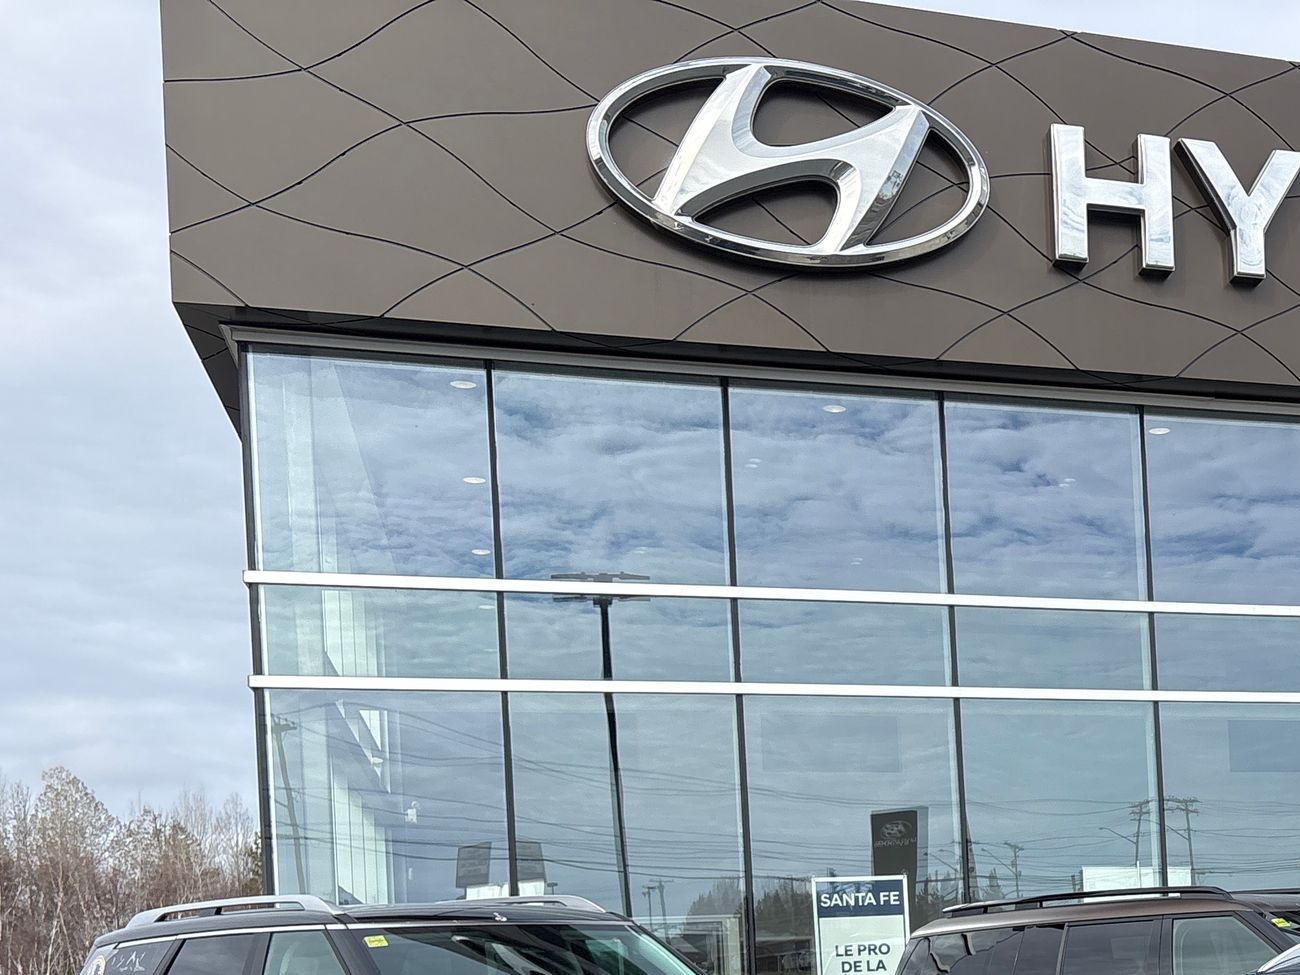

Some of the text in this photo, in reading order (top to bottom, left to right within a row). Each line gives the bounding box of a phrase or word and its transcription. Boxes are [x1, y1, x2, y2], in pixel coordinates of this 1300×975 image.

[820, 891, 900, 908] SANTA FE
[835, 943, 891, 958] LE PRO
[841, 960, 887, 974] DE LA
